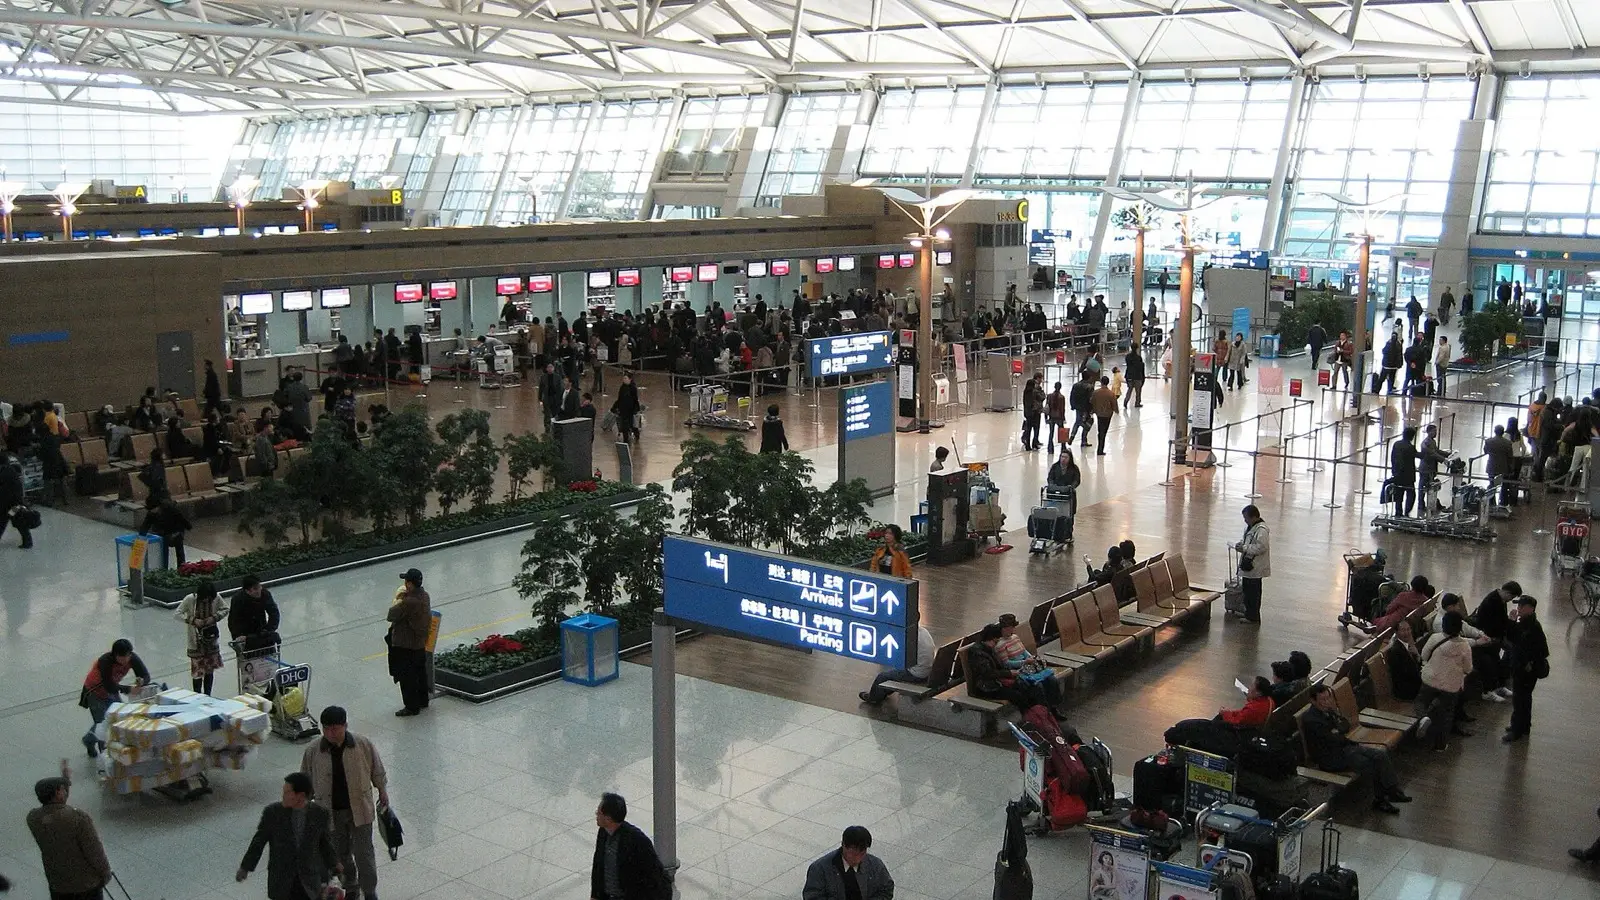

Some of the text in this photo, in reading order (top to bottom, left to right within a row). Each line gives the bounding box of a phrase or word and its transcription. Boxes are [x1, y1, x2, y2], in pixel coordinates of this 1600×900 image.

[135, 186, 145, 197] A
[392, 190, 402, 205] B
[1017, 201, 1027, 222] C
[1562, 526, 1583, 537] BYC
[801, 590, 843, 608] Arrivals
[800, 630, 843, 652] Parking
[856, 630, 872, 651] P
[281, 669, 306, 684] DHC
